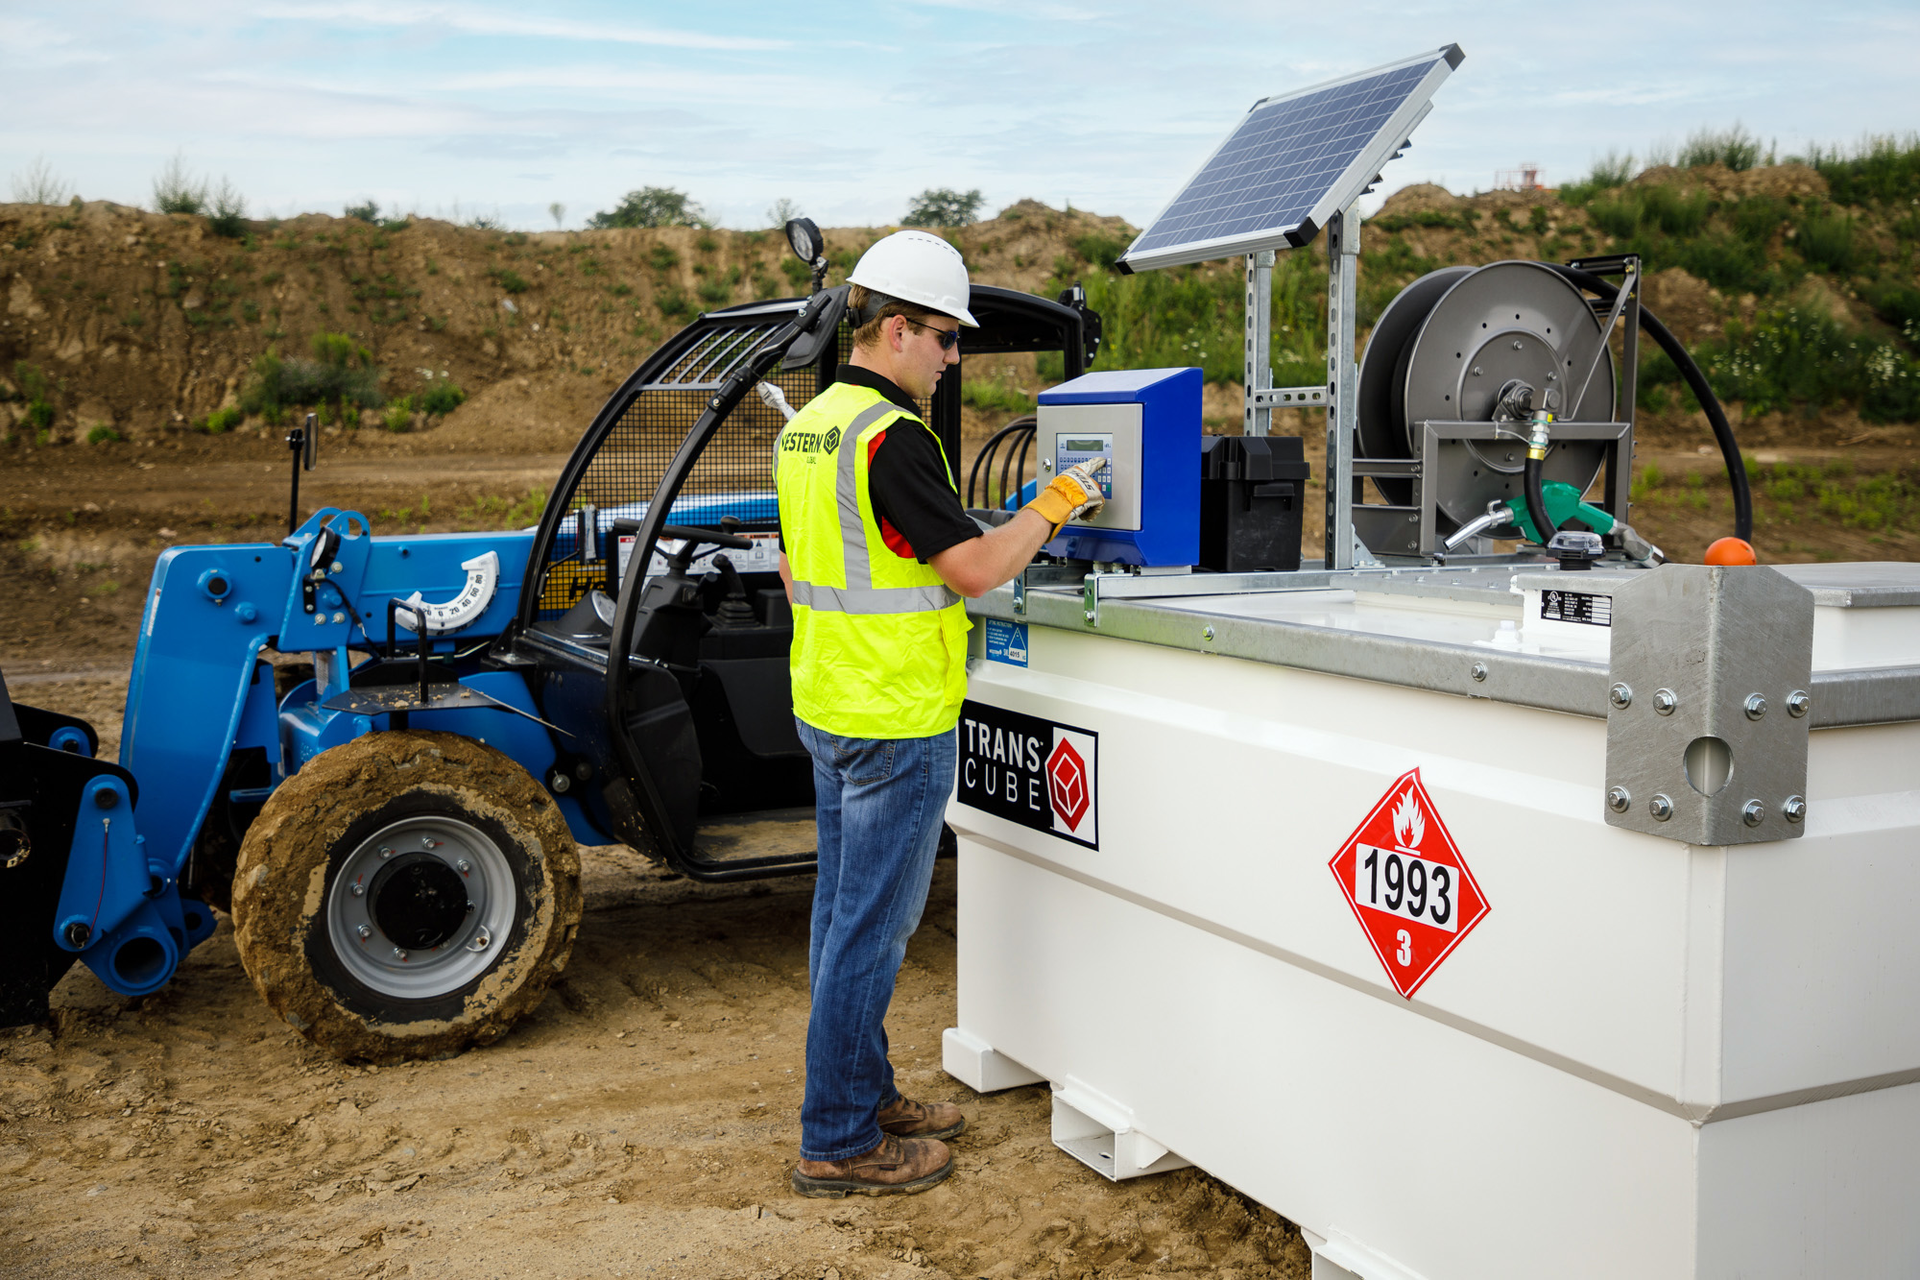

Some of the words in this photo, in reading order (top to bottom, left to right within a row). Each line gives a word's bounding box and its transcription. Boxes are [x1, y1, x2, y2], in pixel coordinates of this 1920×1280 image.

[449, 606, 460, 615] 20
[461, 598, 472, 608] 40
[470, 587, 480, 598] 60
[964, 718, 1040, 773] TRANS
[964, 757, 1041, 811] CUBE
[1364, 848, 1451, 925] 1993
[1396, 929, 1412, 967] 3
